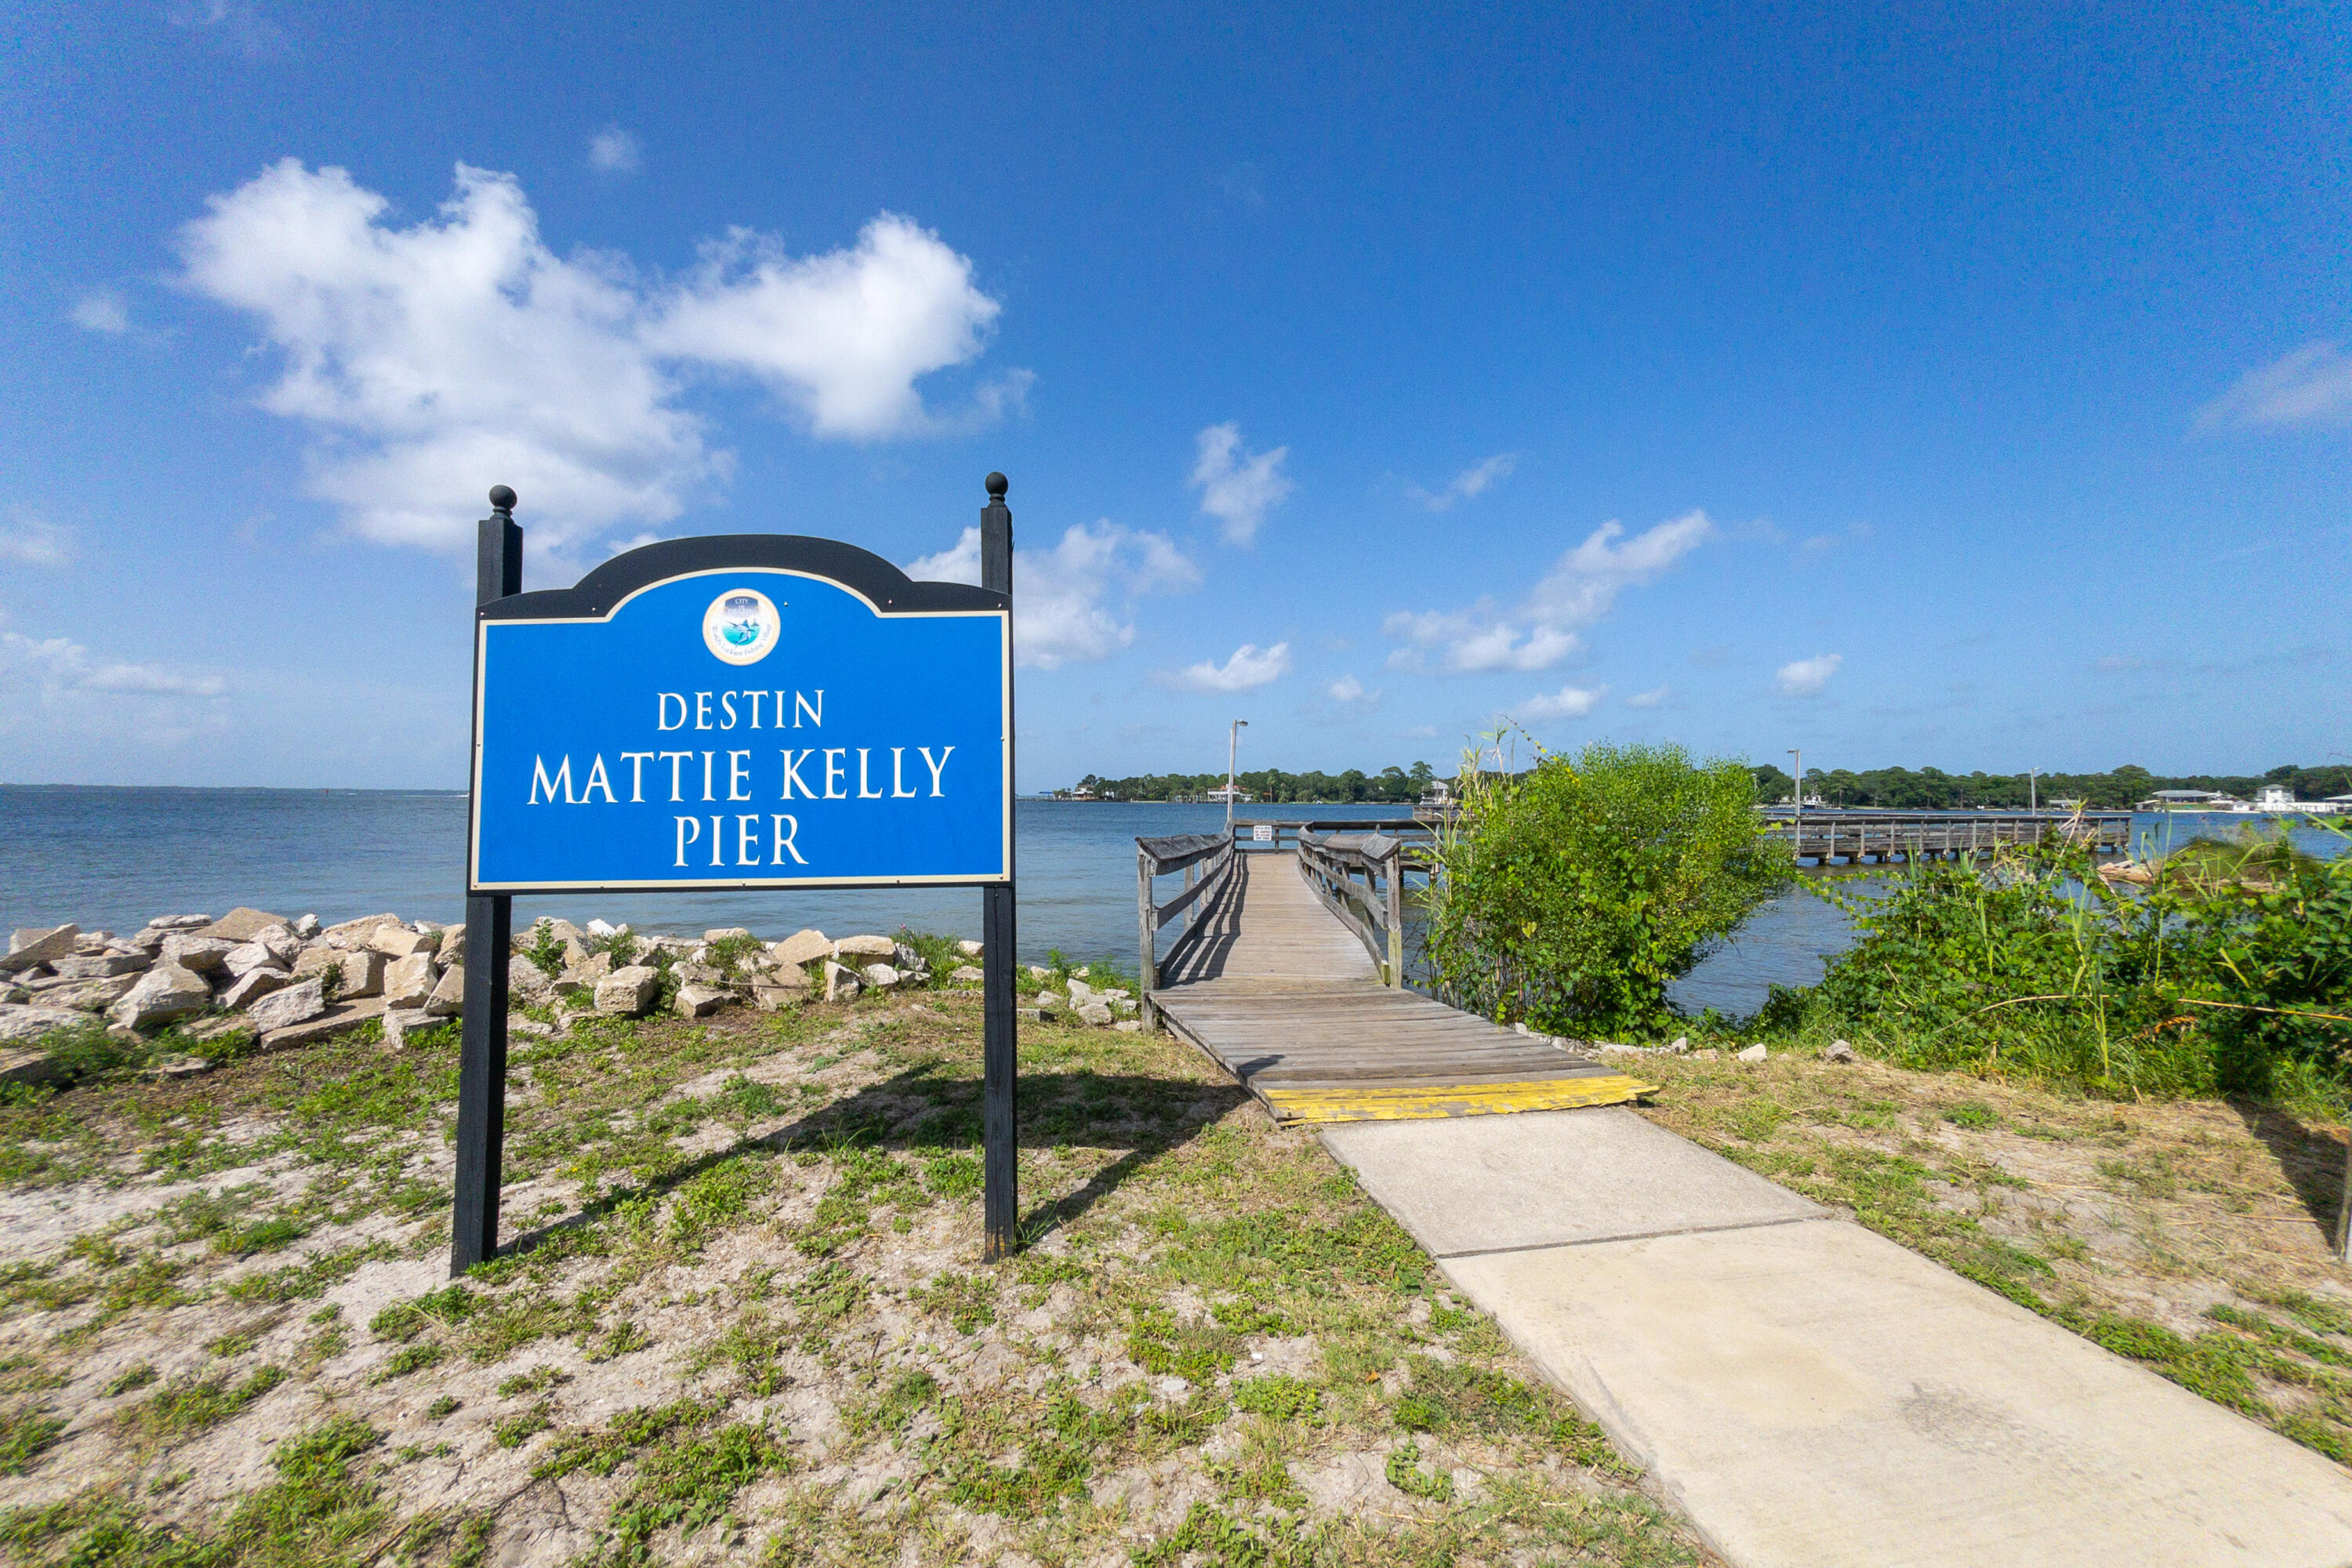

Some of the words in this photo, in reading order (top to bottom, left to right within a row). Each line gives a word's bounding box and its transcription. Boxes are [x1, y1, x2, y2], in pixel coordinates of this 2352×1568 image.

[657, 689, 825, 731] DESTIN
[527, 750, 752, 805] MATTIE
[780, 746, 956, 800] KELLY
[673, 815, 809, 867] PIER
